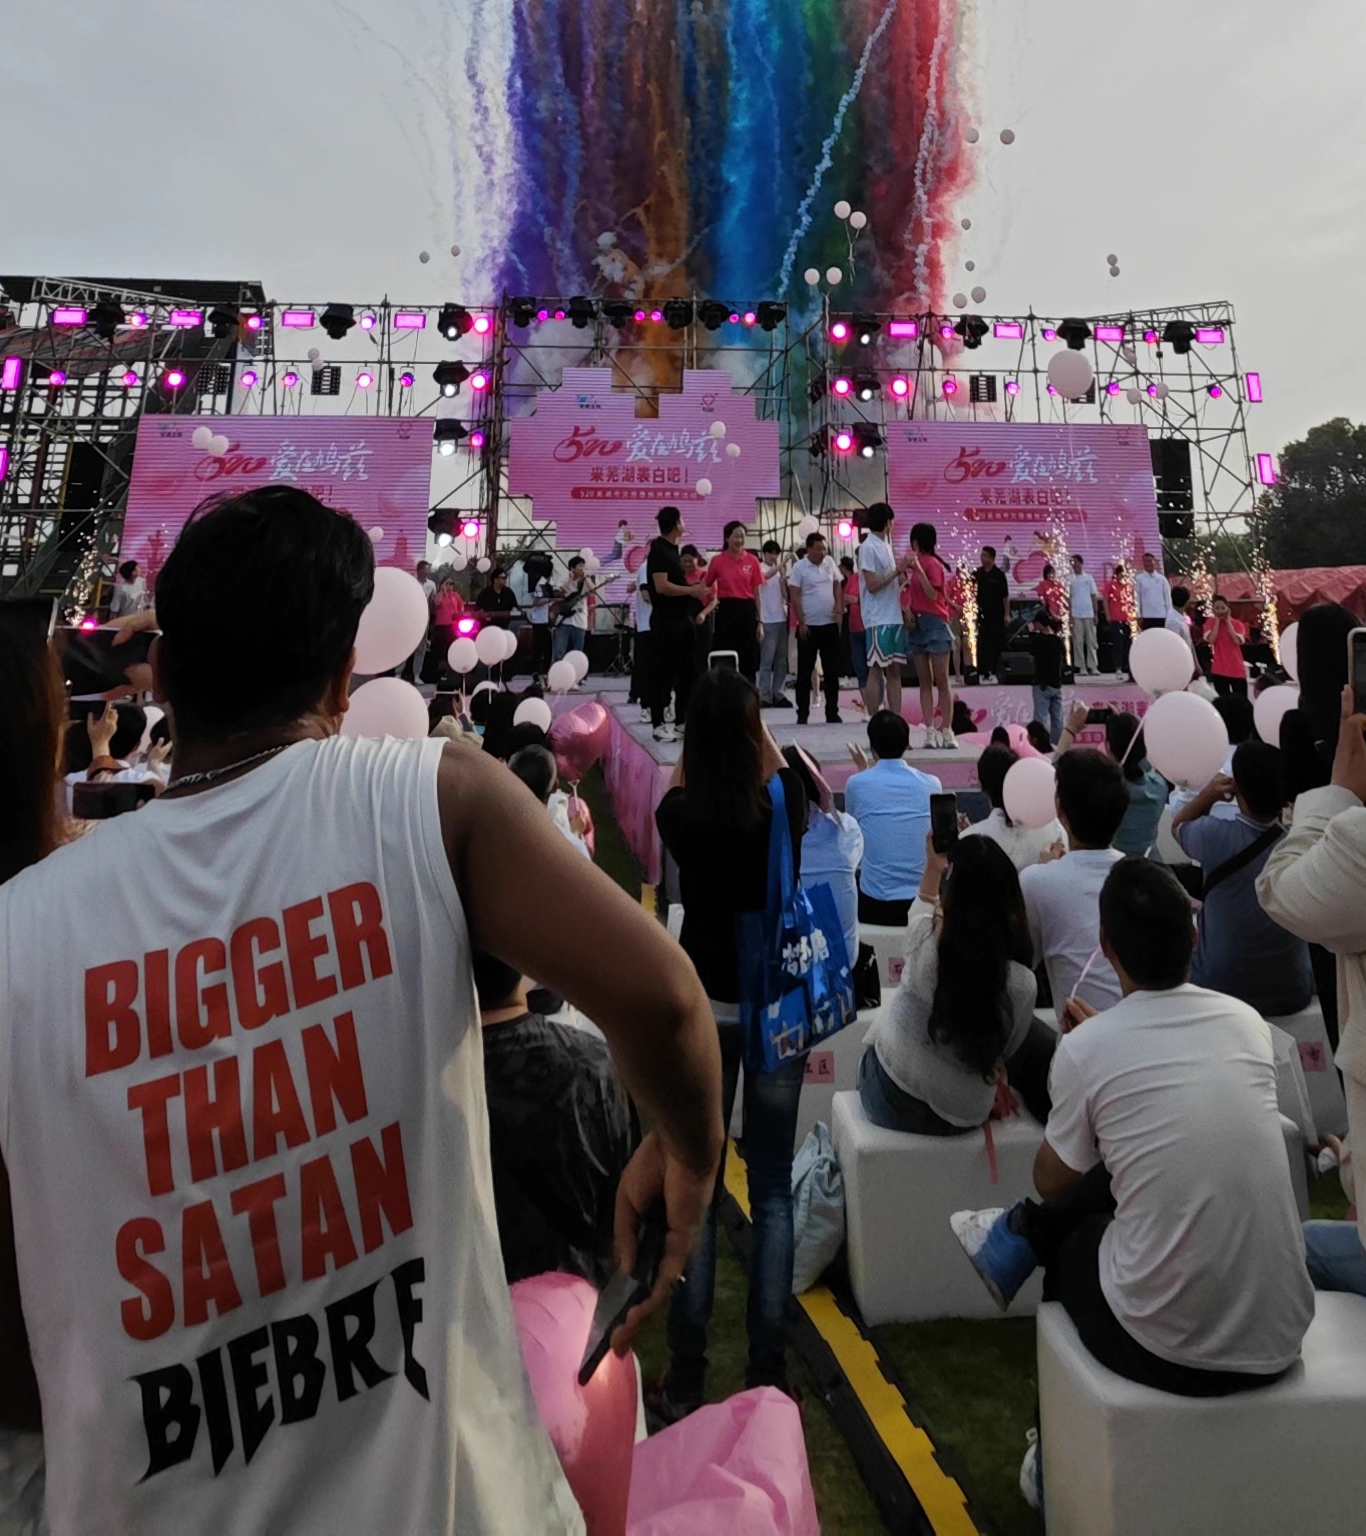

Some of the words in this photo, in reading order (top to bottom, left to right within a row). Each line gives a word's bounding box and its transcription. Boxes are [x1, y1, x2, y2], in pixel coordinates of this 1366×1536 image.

[84, 880, 394, 1078] BIGGER
[126, 1010, 369, 1198] THAN
[114, 1123, 415, 1343] SATAN
